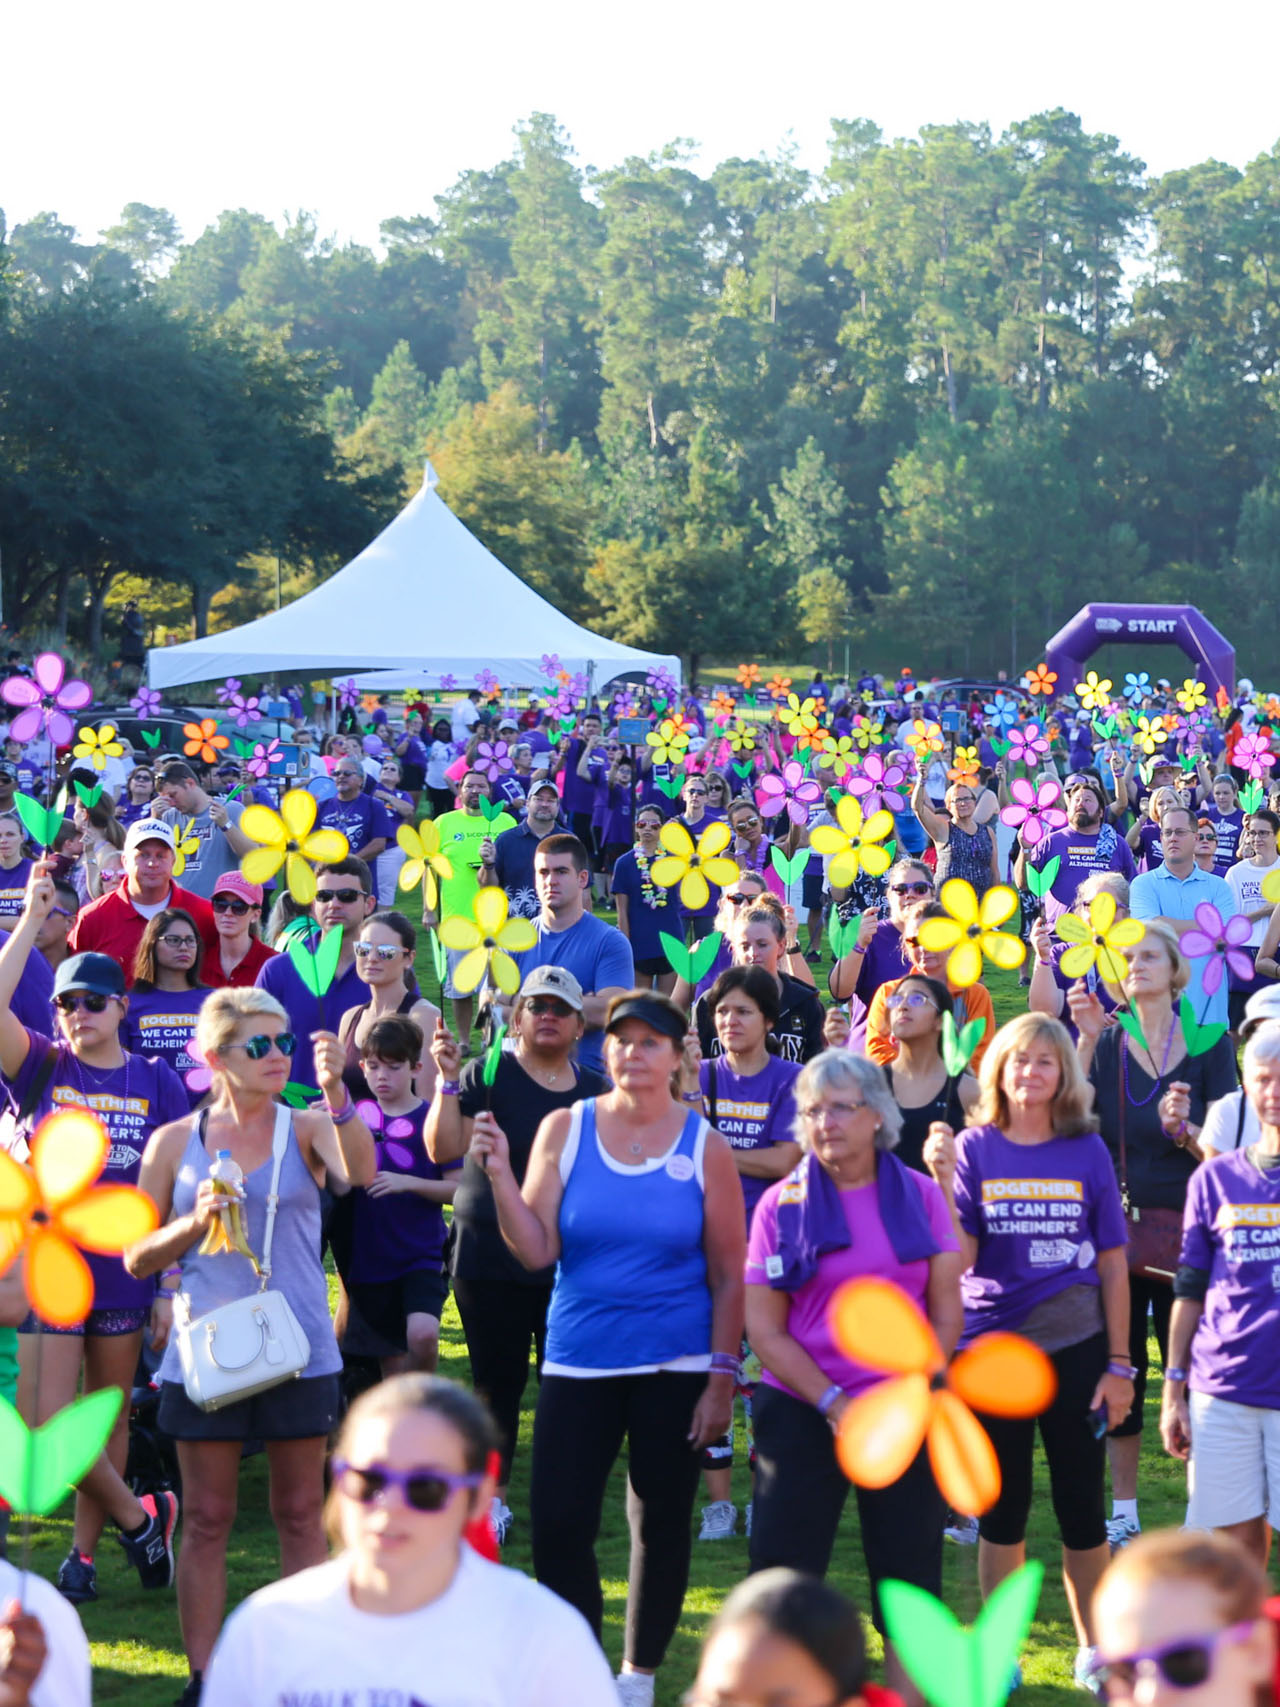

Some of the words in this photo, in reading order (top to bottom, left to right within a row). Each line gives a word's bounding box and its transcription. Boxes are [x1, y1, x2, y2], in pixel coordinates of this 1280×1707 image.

[1128, 619, 1177, 632] START
[141, 1030, 161, 1038] WE
[163, 1029, 187, 1037] CAN
[113, 1114, 146, 1126] END
[718, 1120, 744, 1133] CAN
[984, 1204, 1010, 1218] WE
[1012, 1203, 1047, 1217] CAN
[1050, 1203, 1082, 1217] END
